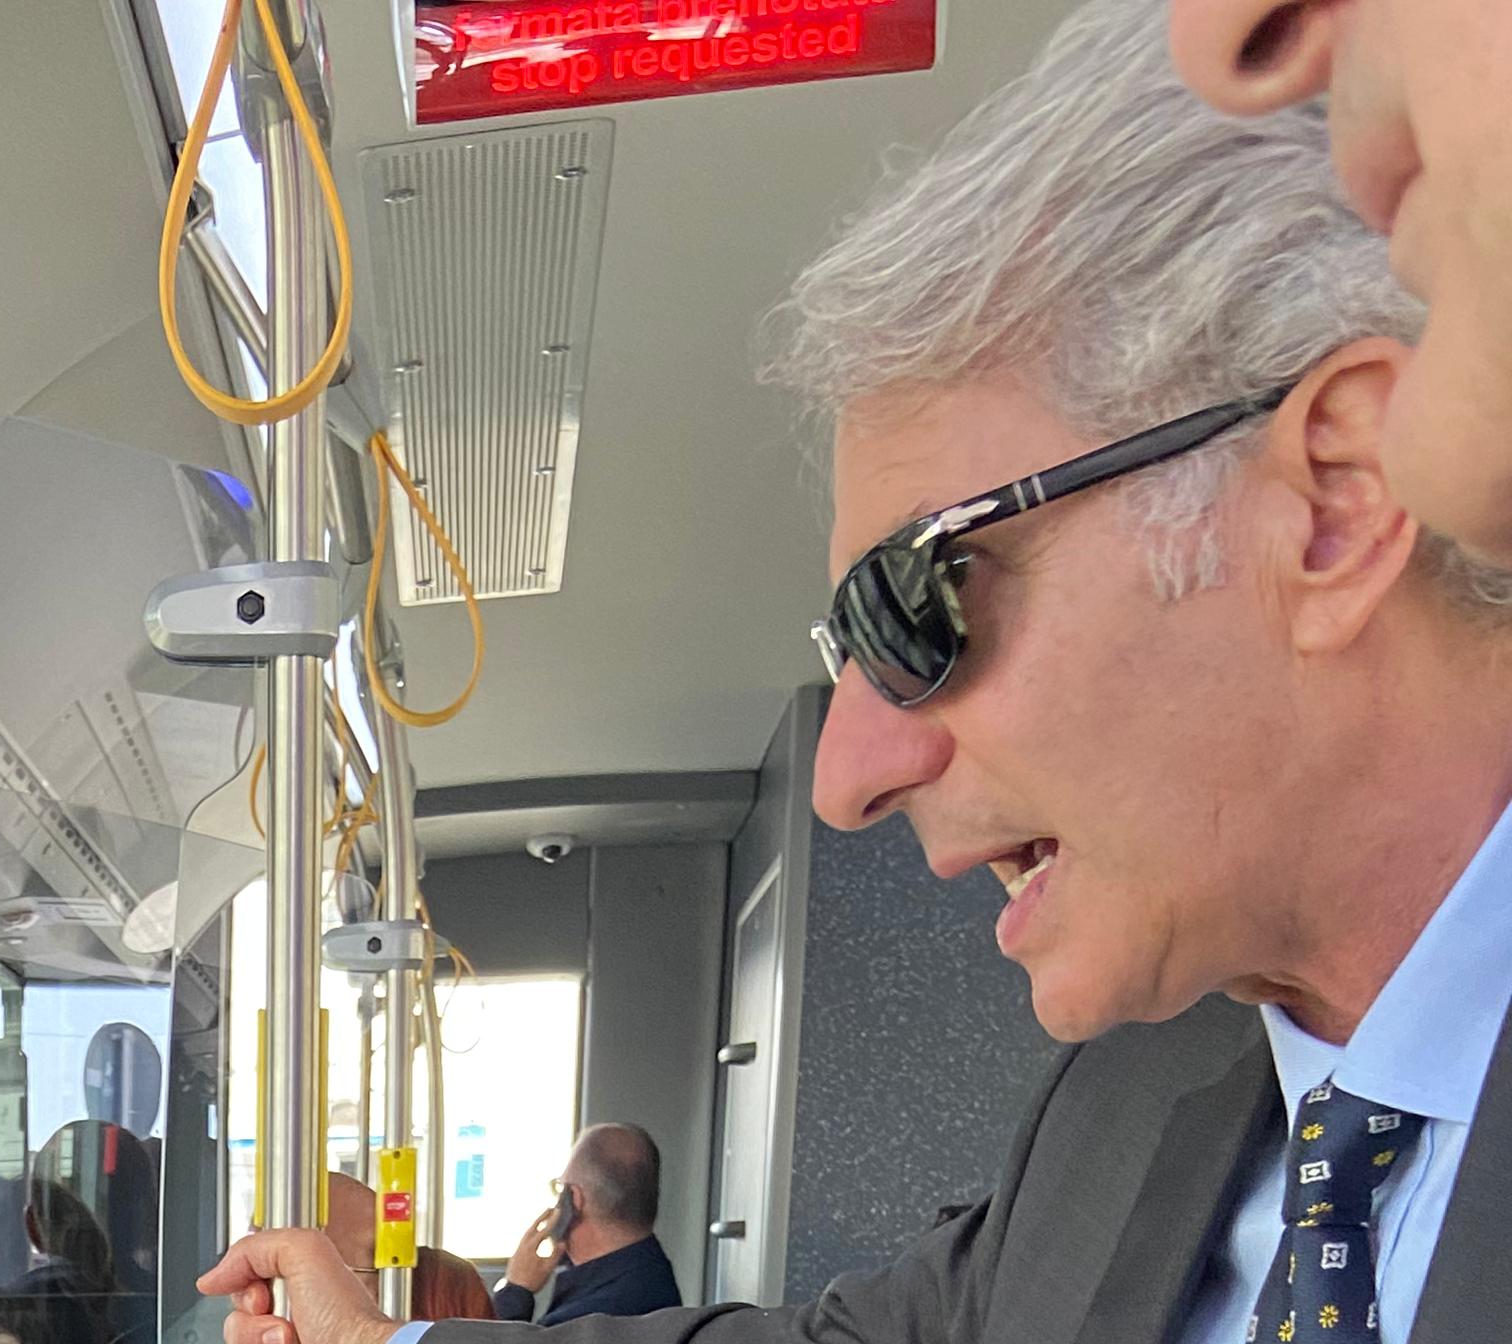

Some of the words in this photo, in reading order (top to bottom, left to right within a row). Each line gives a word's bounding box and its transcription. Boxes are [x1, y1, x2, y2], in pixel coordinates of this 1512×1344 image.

[455, 0, 641, 51] fermata
[491, 52, 599, 93] stop
[613, 14, 858, 81] requested
